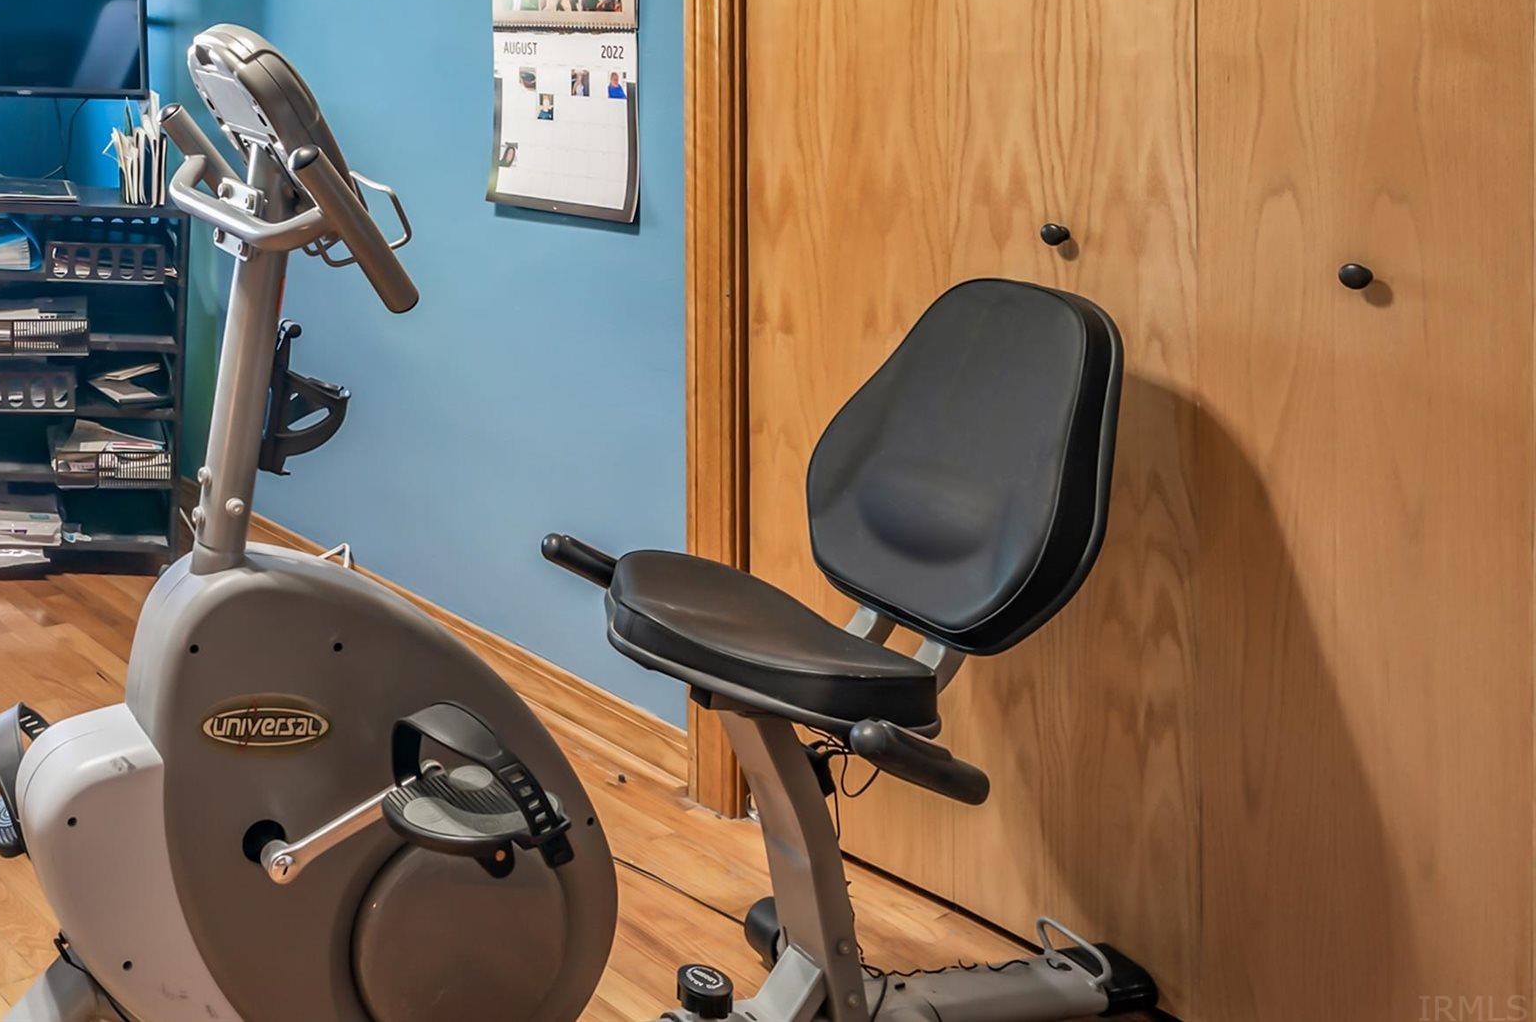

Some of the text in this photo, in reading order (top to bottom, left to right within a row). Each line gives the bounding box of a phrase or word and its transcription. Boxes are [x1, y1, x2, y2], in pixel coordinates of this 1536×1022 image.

[504, 41, 624, 59] AUGUST 2022
[213, 717, 318, 737] universal
